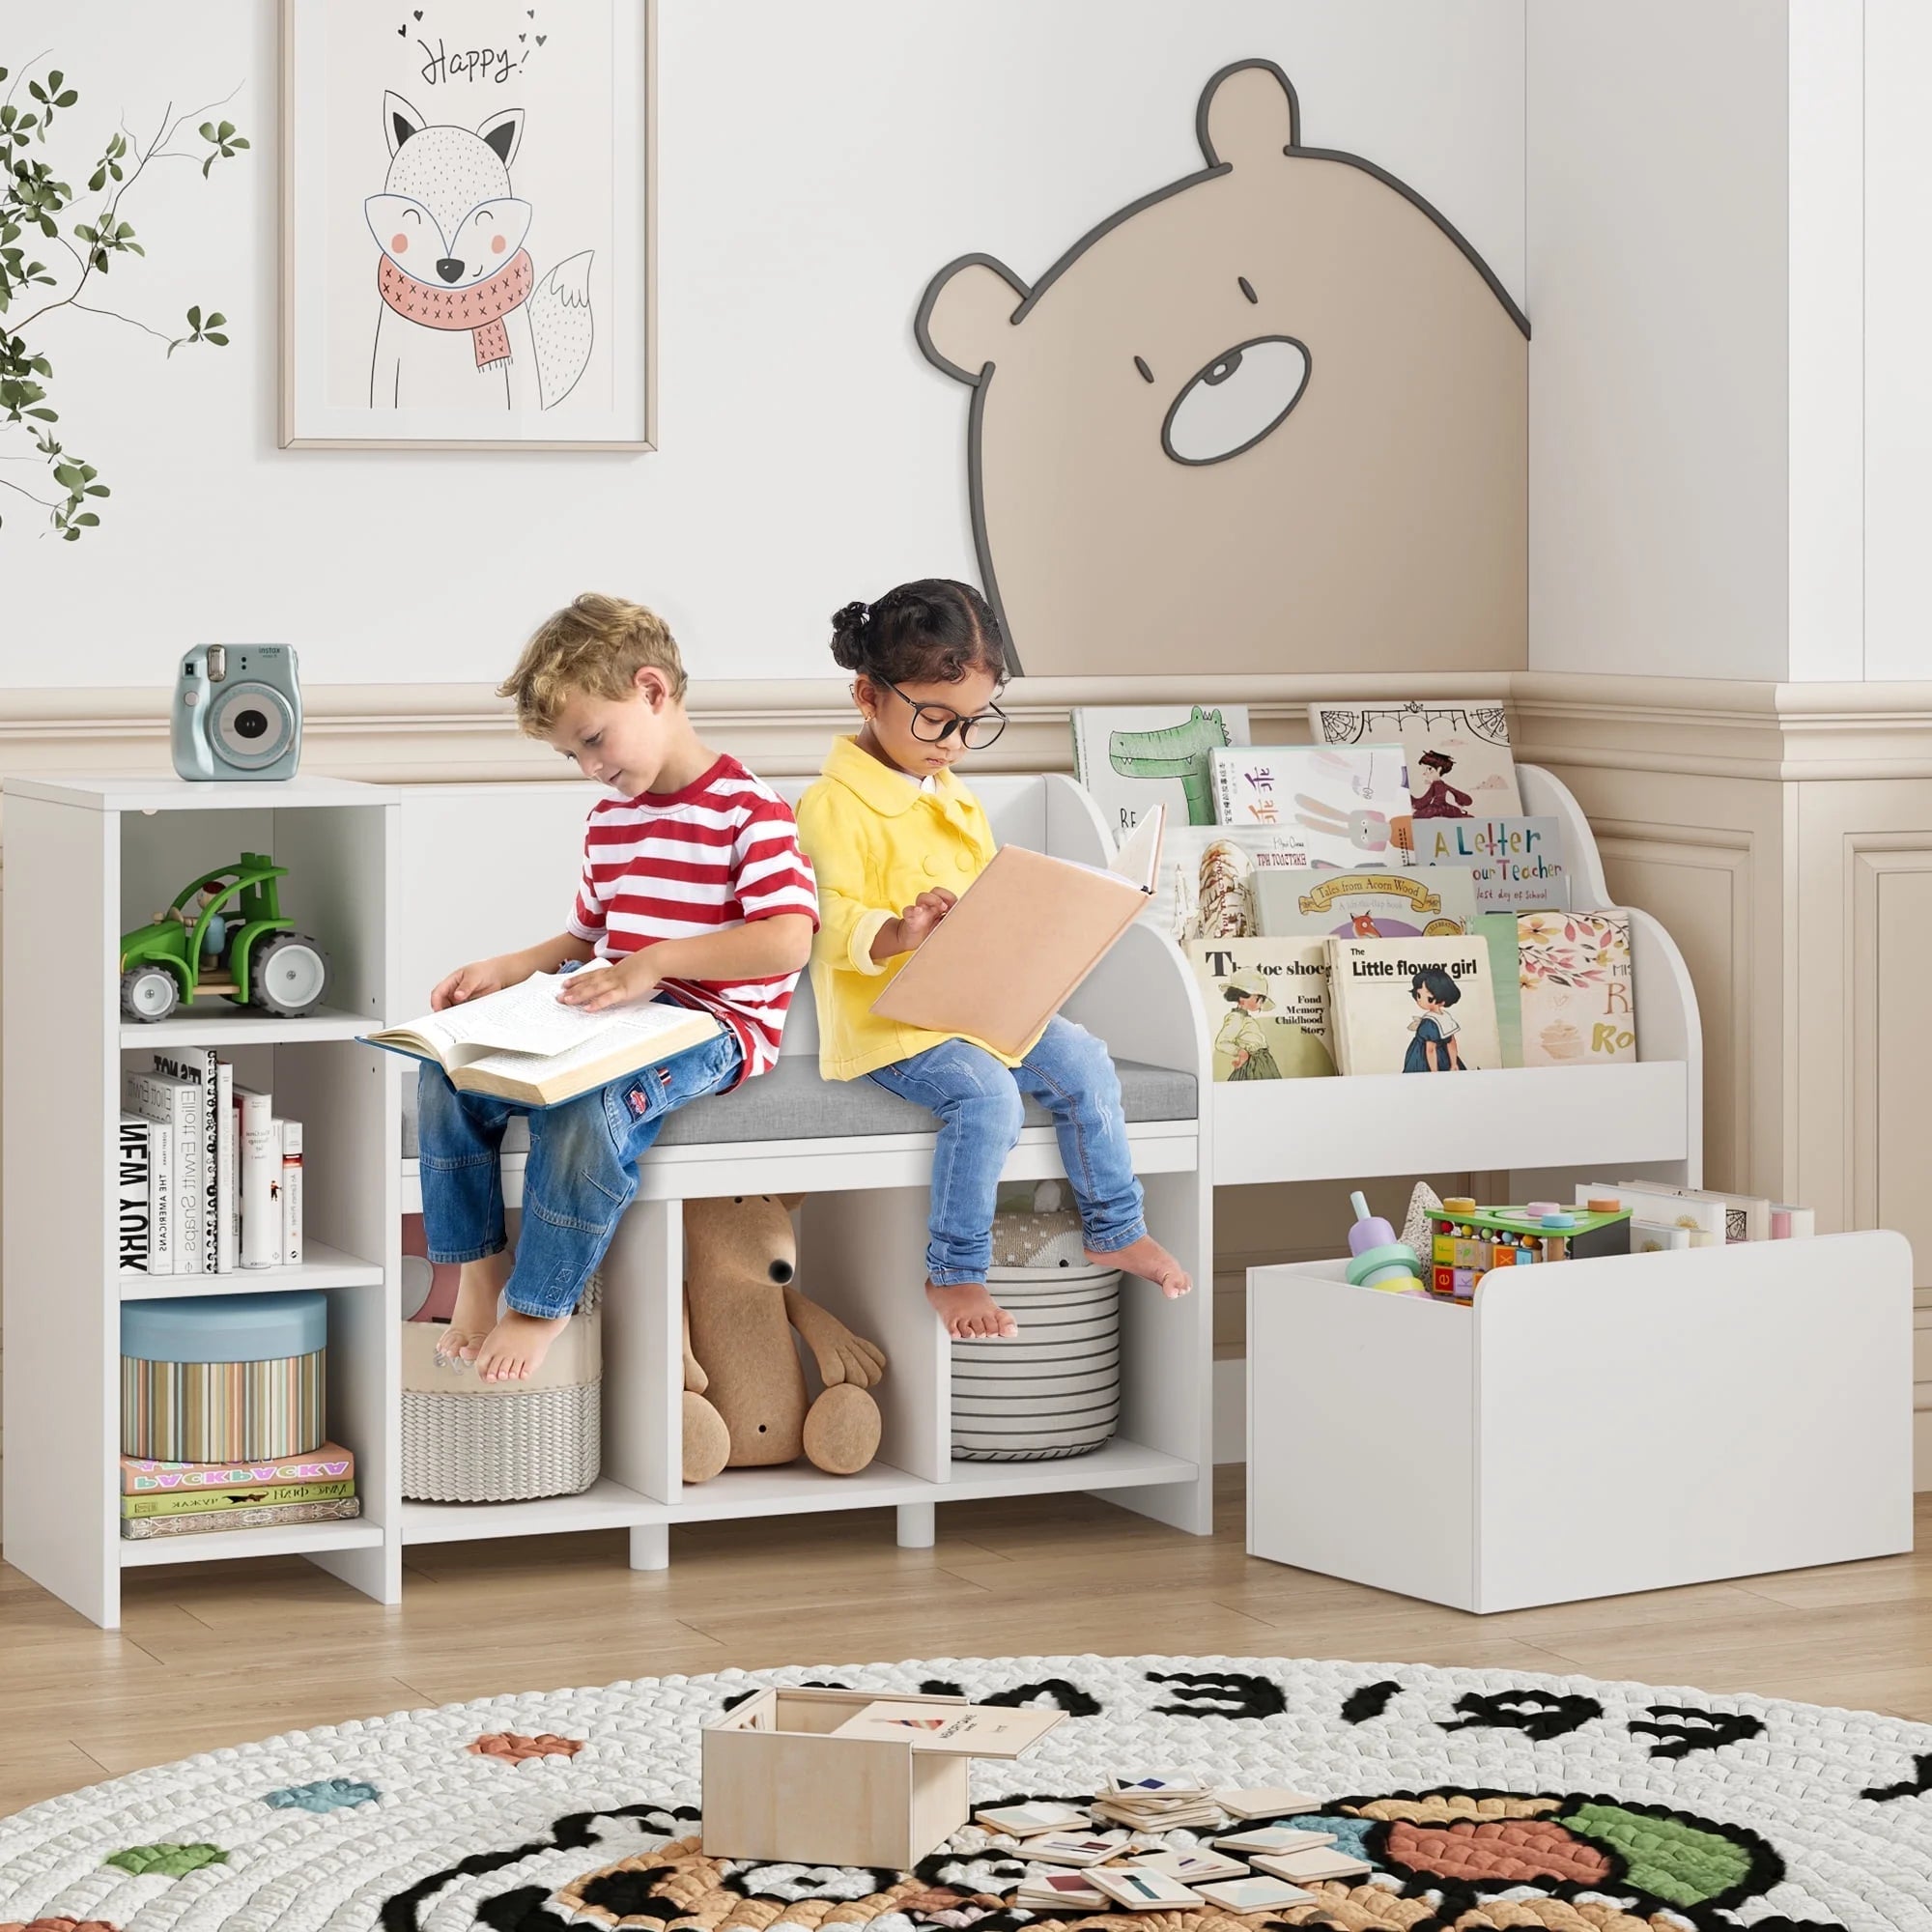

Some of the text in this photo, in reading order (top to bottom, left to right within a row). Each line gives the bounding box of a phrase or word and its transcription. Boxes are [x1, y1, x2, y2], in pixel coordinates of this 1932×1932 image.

[417, 39, 529, 84] Happy!
[1435, 832, 1450, 858] A
[1456, 822, 1541, 857] Letter
[1495, 855, 1562, 881] Teacher
[1317, 878, 1420, 898] Tales from Acorn Wood
[1497, 889, 1511, 902] day
[1514, 890, 1523, 899] of
[1257, 962, 1283, 976] toe
[1352, 960, 1393, 977] Little
[1451, 959, 1477, 980] girl
[1297, 995, 1321, 1004] Fond
[1287, 1006, 1324, 1015] Memory
[1275, 1014, 1323, 1024] Childhood
[1300, 1026, 1326, 1036] Story
[1592, 1022, 1634, 1054] Ro
[1439, 1274, 1450, 1285] e
